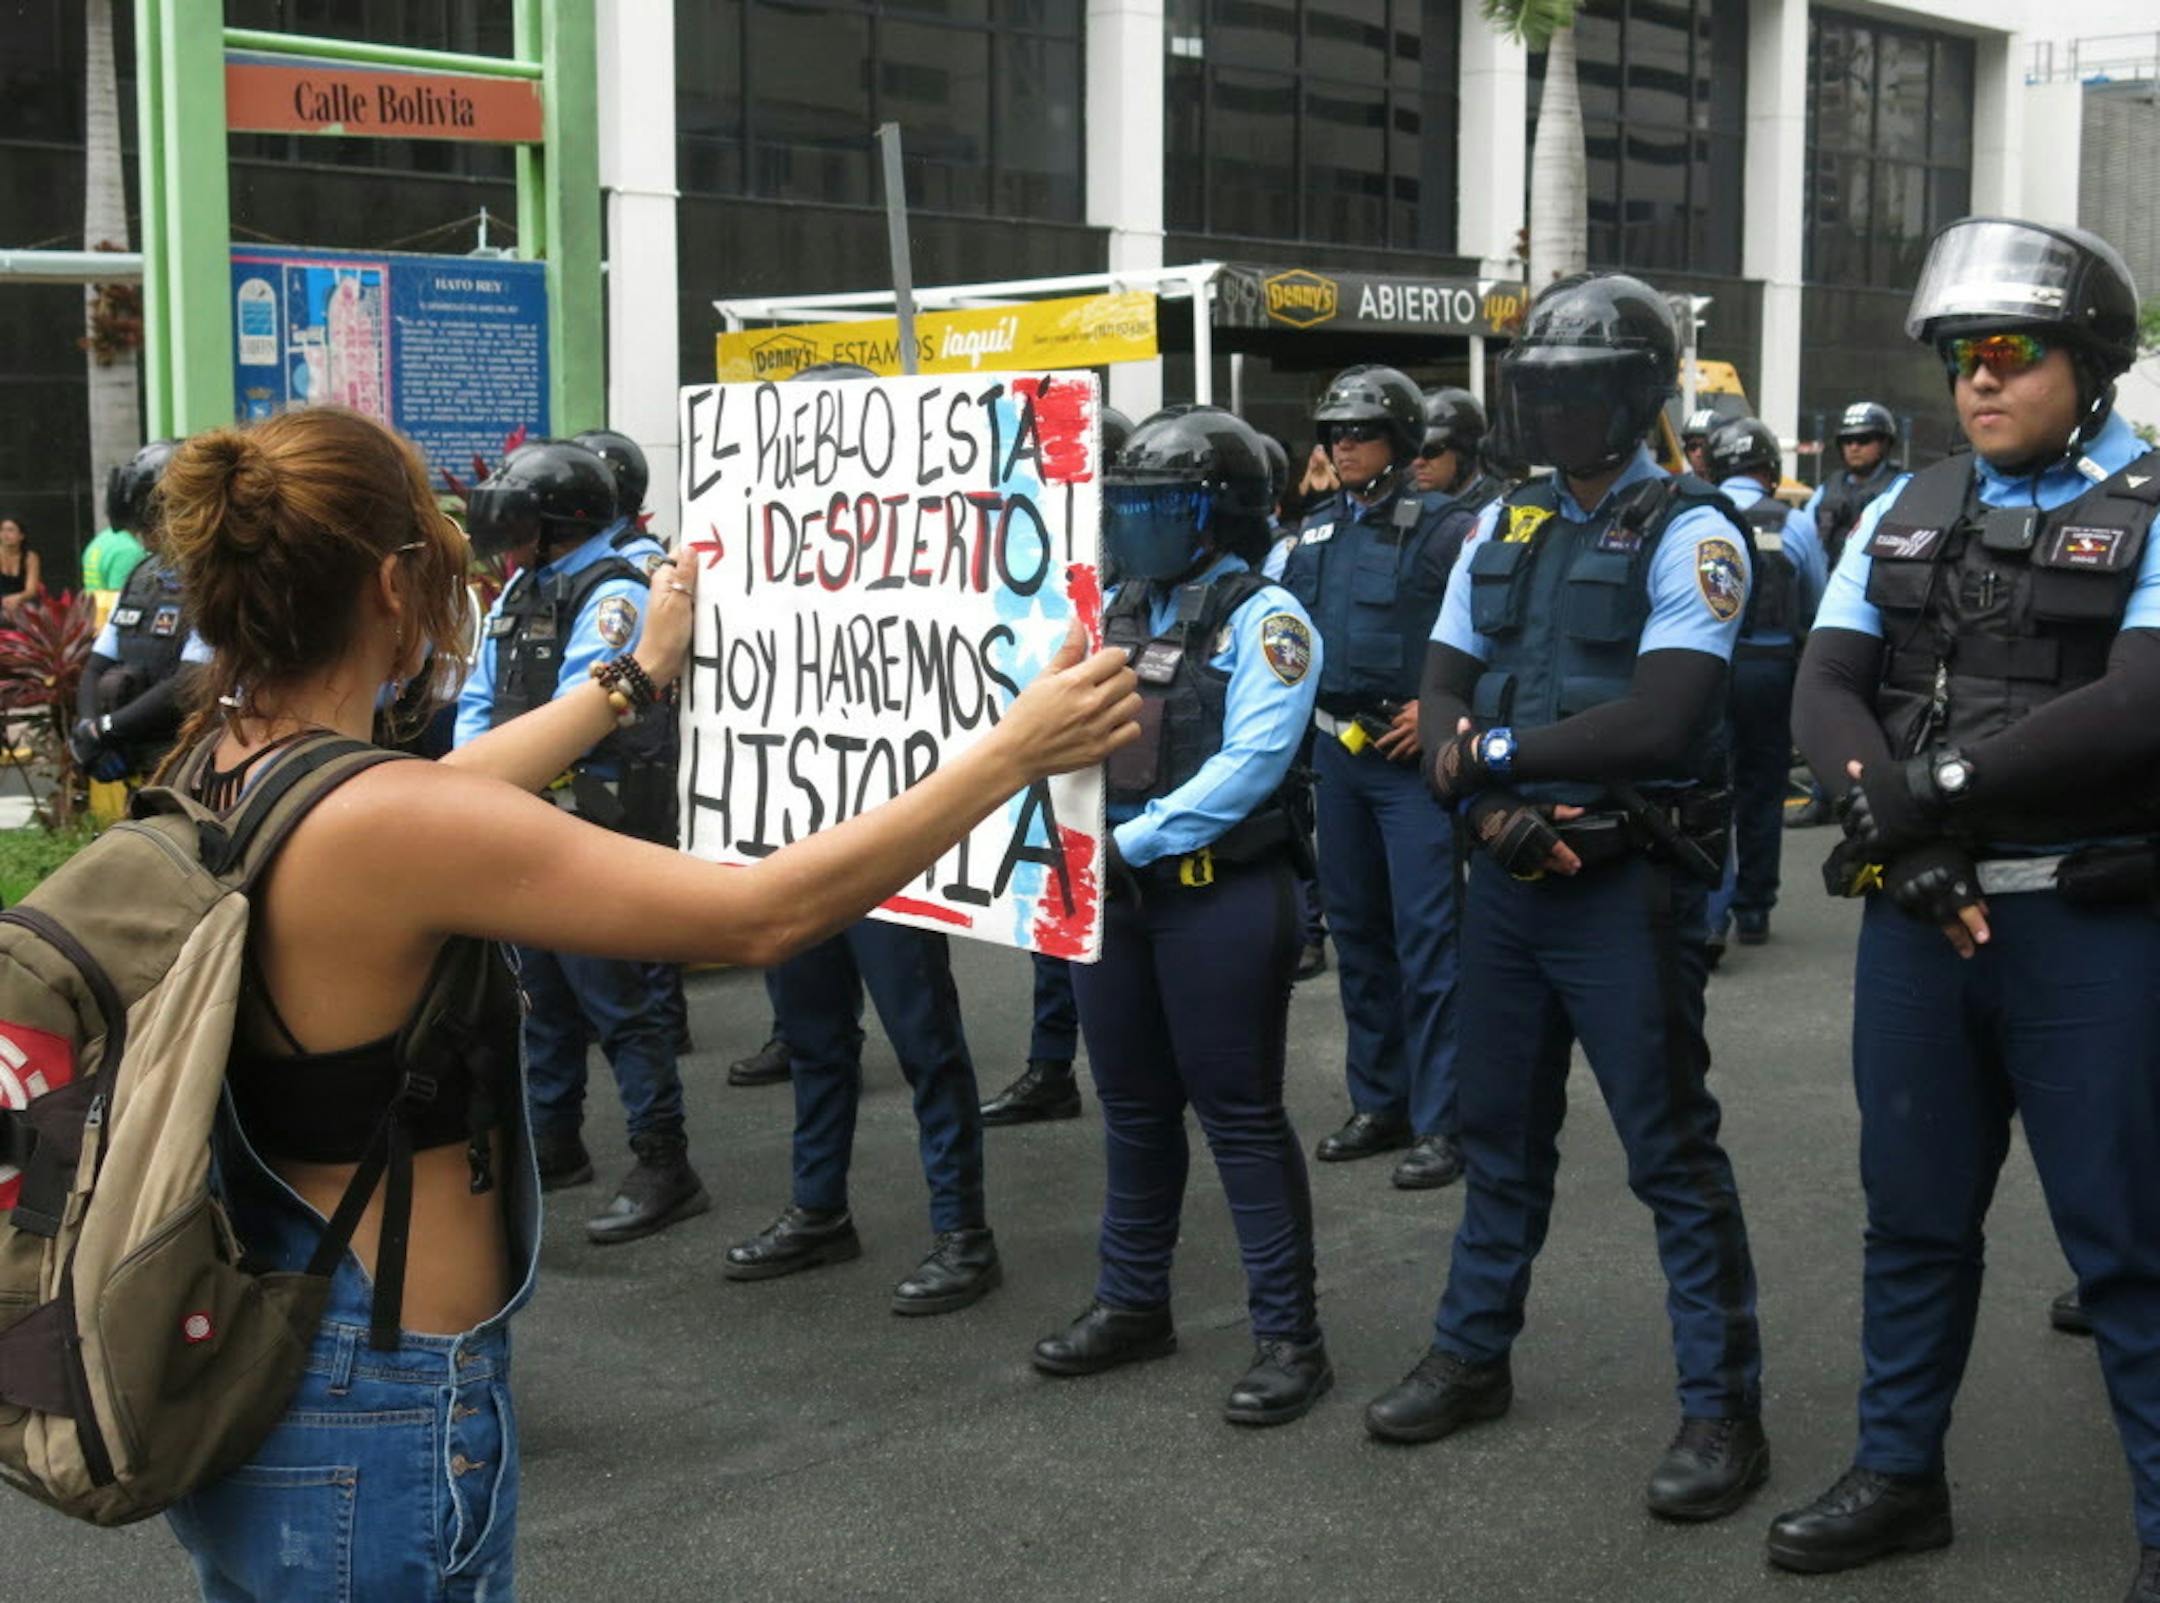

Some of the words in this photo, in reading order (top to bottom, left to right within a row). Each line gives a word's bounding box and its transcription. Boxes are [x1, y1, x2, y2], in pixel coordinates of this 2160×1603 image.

[294, 81, 366, 123] Calle
[378, 84, 474, 127] Bolivia
[435, 278, 472, 292] HATO
[475, 279, 503, 293] REY
[1270, 282, 1332, 312] Denny's
[1358, 284, 1475, 324] ABIERTO
[755, 343, 811, 372] Denny's
[832, 335, 934, 367] ESTAMS
[688, 388, 741, 501] EL
[916, 374, 1051, 488] ESTÁ
[745, 486, 1075, 597] ¡DESPIERTO!
[690, 603, 777, 728] HOY
[796, 610, 1021, 739] HAREMOS
